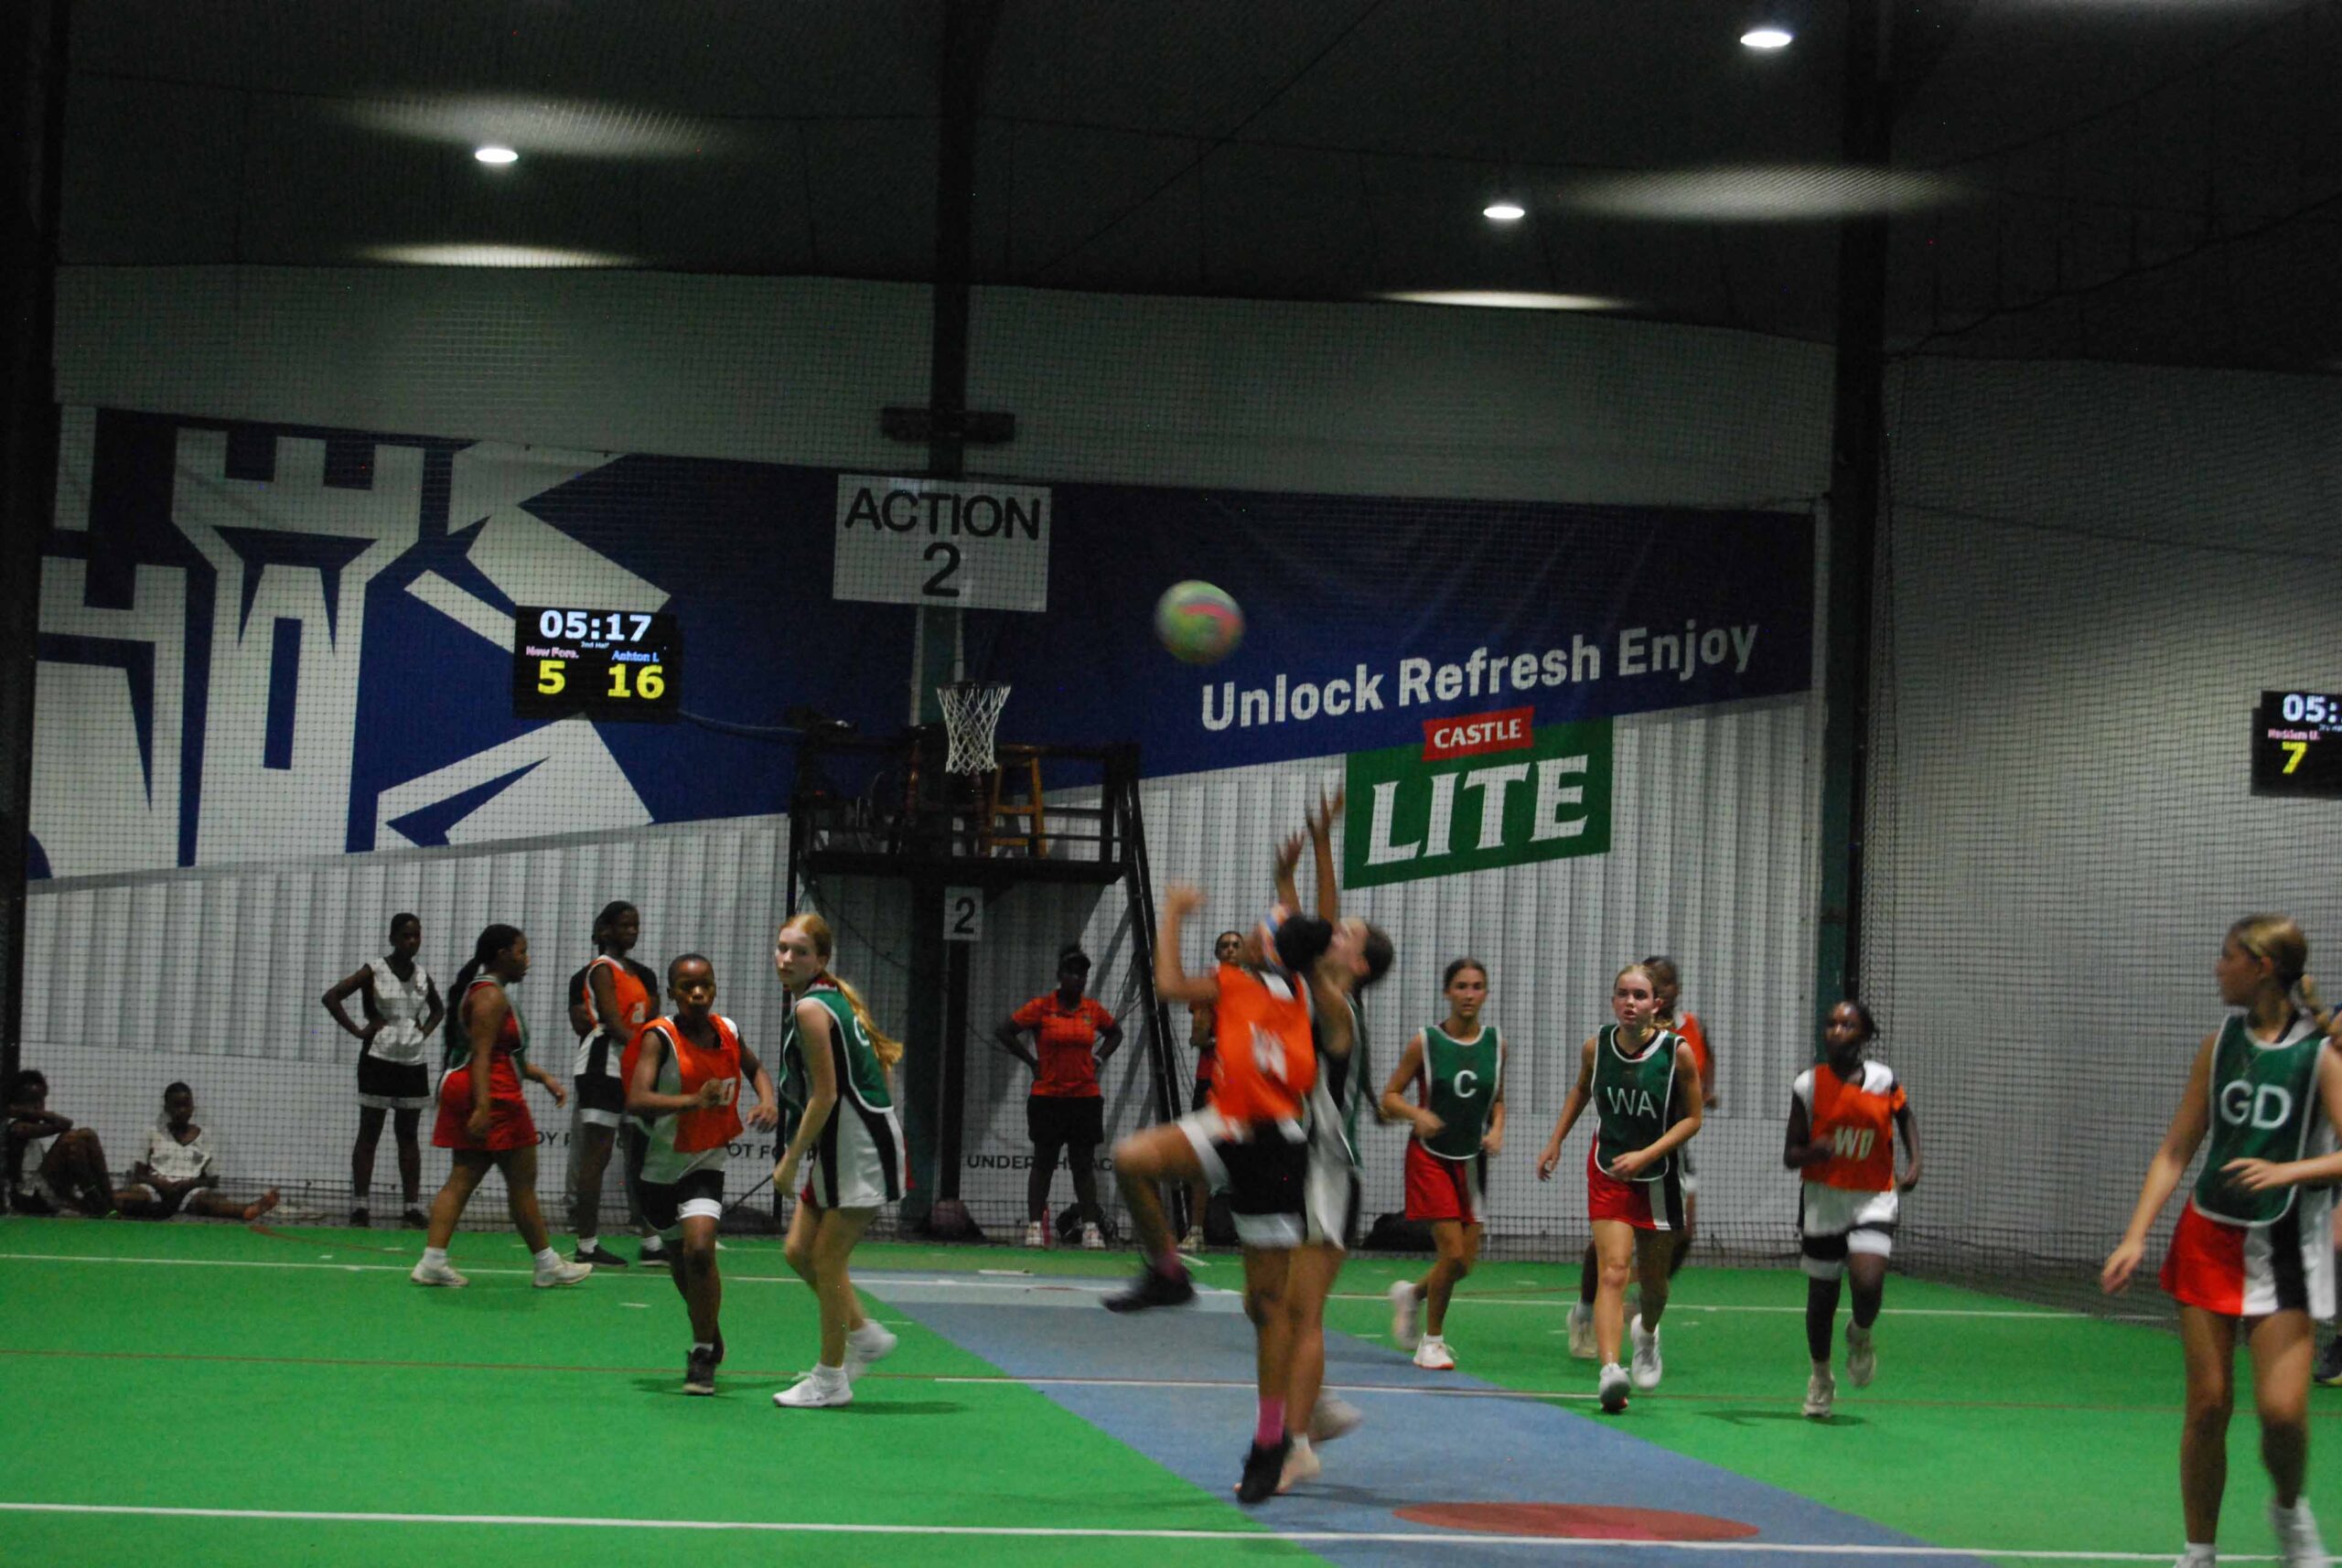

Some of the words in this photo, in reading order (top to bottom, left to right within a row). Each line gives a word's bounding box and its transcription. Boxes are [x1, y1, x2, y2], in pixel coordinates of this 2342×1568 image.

[844, 488, 1040, 542] ACTION
[922, 542, 961, 597] 2
[540, 609, 652, 642] 05:17
[611, 650, 650, 662] Ashton
[537, 660, 566, 694] 5
[607, 662, 665, 700] 16
[1201, 662, 1385, 732] Unlock
[1399, 634, 1601, 707] Refresh
[1617, 618, 1758, 683] Enjoy
[2283, 693, 2342, 724] 05:
[1434, 716, 1522, 749] CASTLE
[2282, 741, 2308, 775] 7
[1365, 755, 1589, 867] LITE
[953, 897, 975, 934] 2
[1453, 1069, 1478, 1099] C
[1606, 1086, 1658, 1120] WA
[2219, 1078, 2293, 1130] GD
[1833, 1123, 1876, 1162] WD
